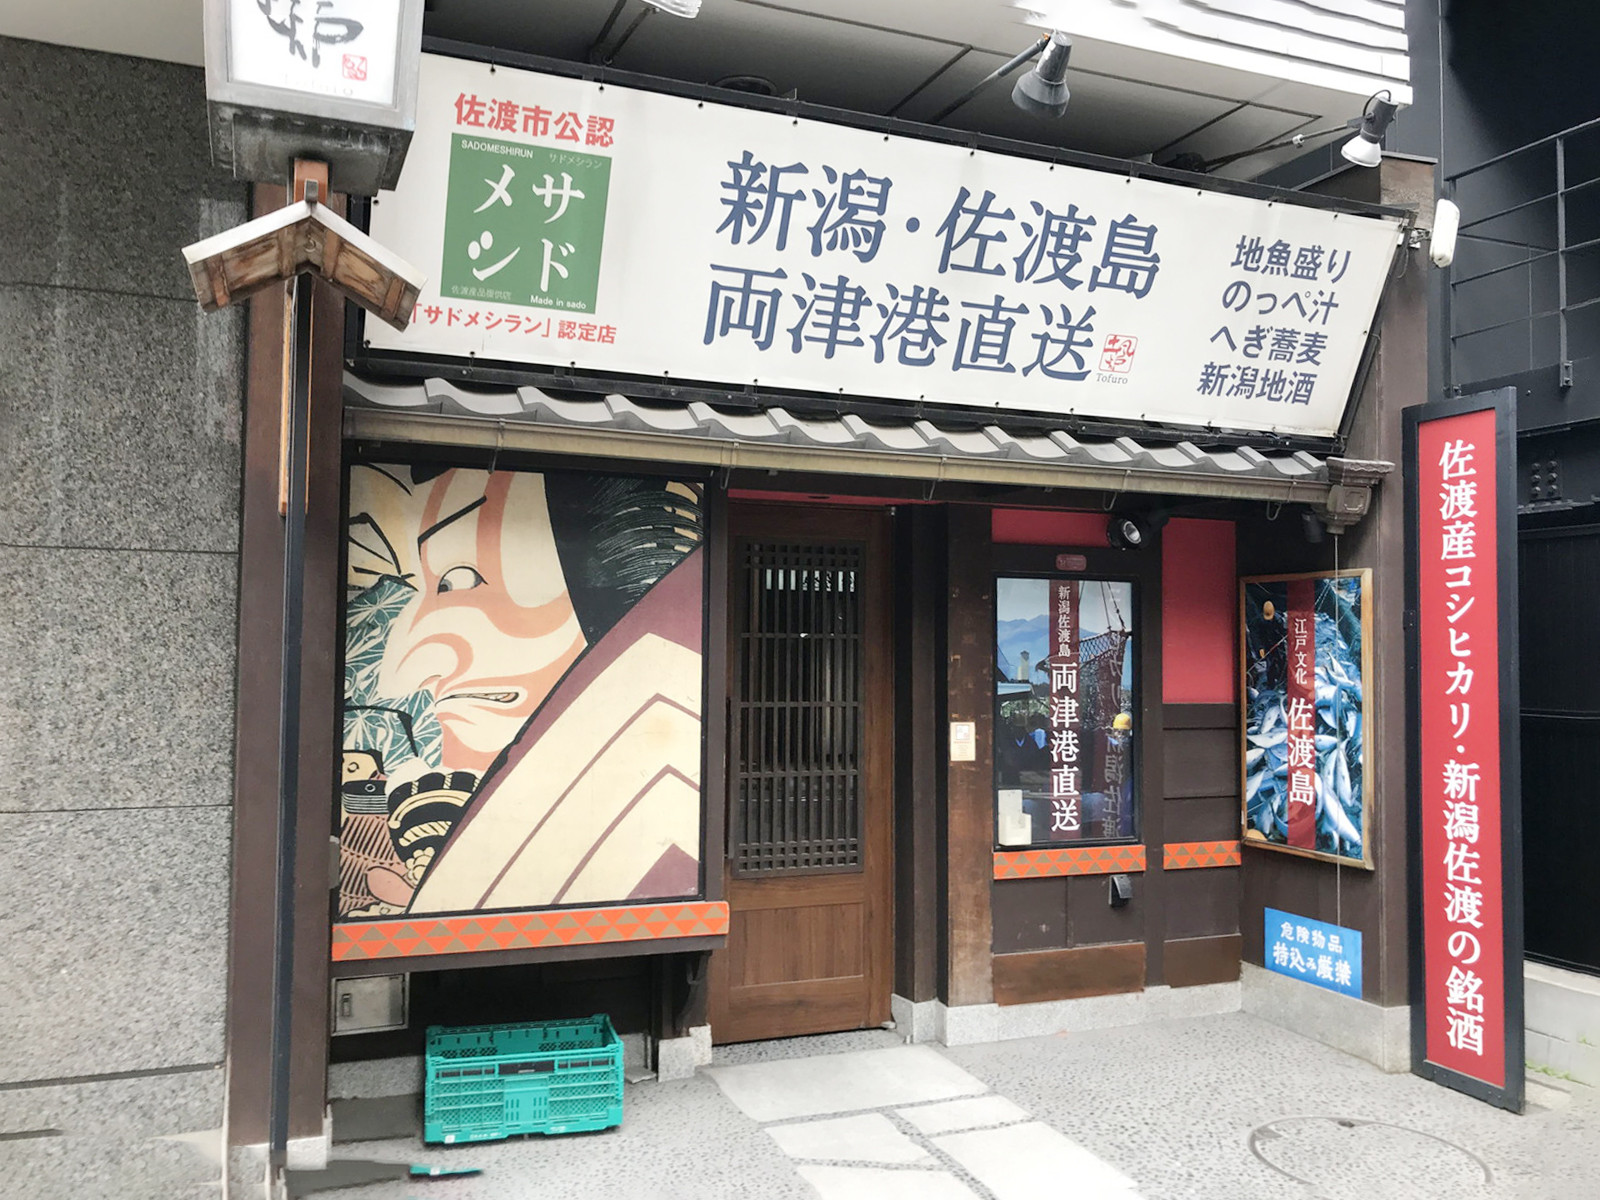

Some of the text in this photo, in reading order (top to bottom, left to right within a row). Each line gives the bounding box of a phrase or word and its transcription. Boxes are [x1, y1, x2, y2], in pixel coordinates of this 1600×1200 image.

[454, 92, 615, 148] 佐渡市公認
[461, 139, 534, 159] SADOMESHIRUN
[715, 149, 1160, 300] 新潟・佐渡島
[1230, 234, 1351, 284] 地魚盛り
[530, 294, 587, 310] Made in sado
[702, 263, 1098, 382] 両津港直送
[1221, 280, 1340, 325] のっぺ汁
[1209, 325, 1328, 366] へぎ蕎麦
[1096, 372, 1129, 385] Tofuro
[1197, 361, 1318, 406] 新潟地酒
[1057, 585, 1071, 658] 新潟佐渡島
[1294, 618, 1308, 685] 江戸文化
[1050, 661, 1081, 833] 両津港直送
[1287, 697, 1315, 806] 佐渡島
[1280, 921, 1343, 954] 危険物品
[1272, 941, 1352, 987] 持込み厳禁
